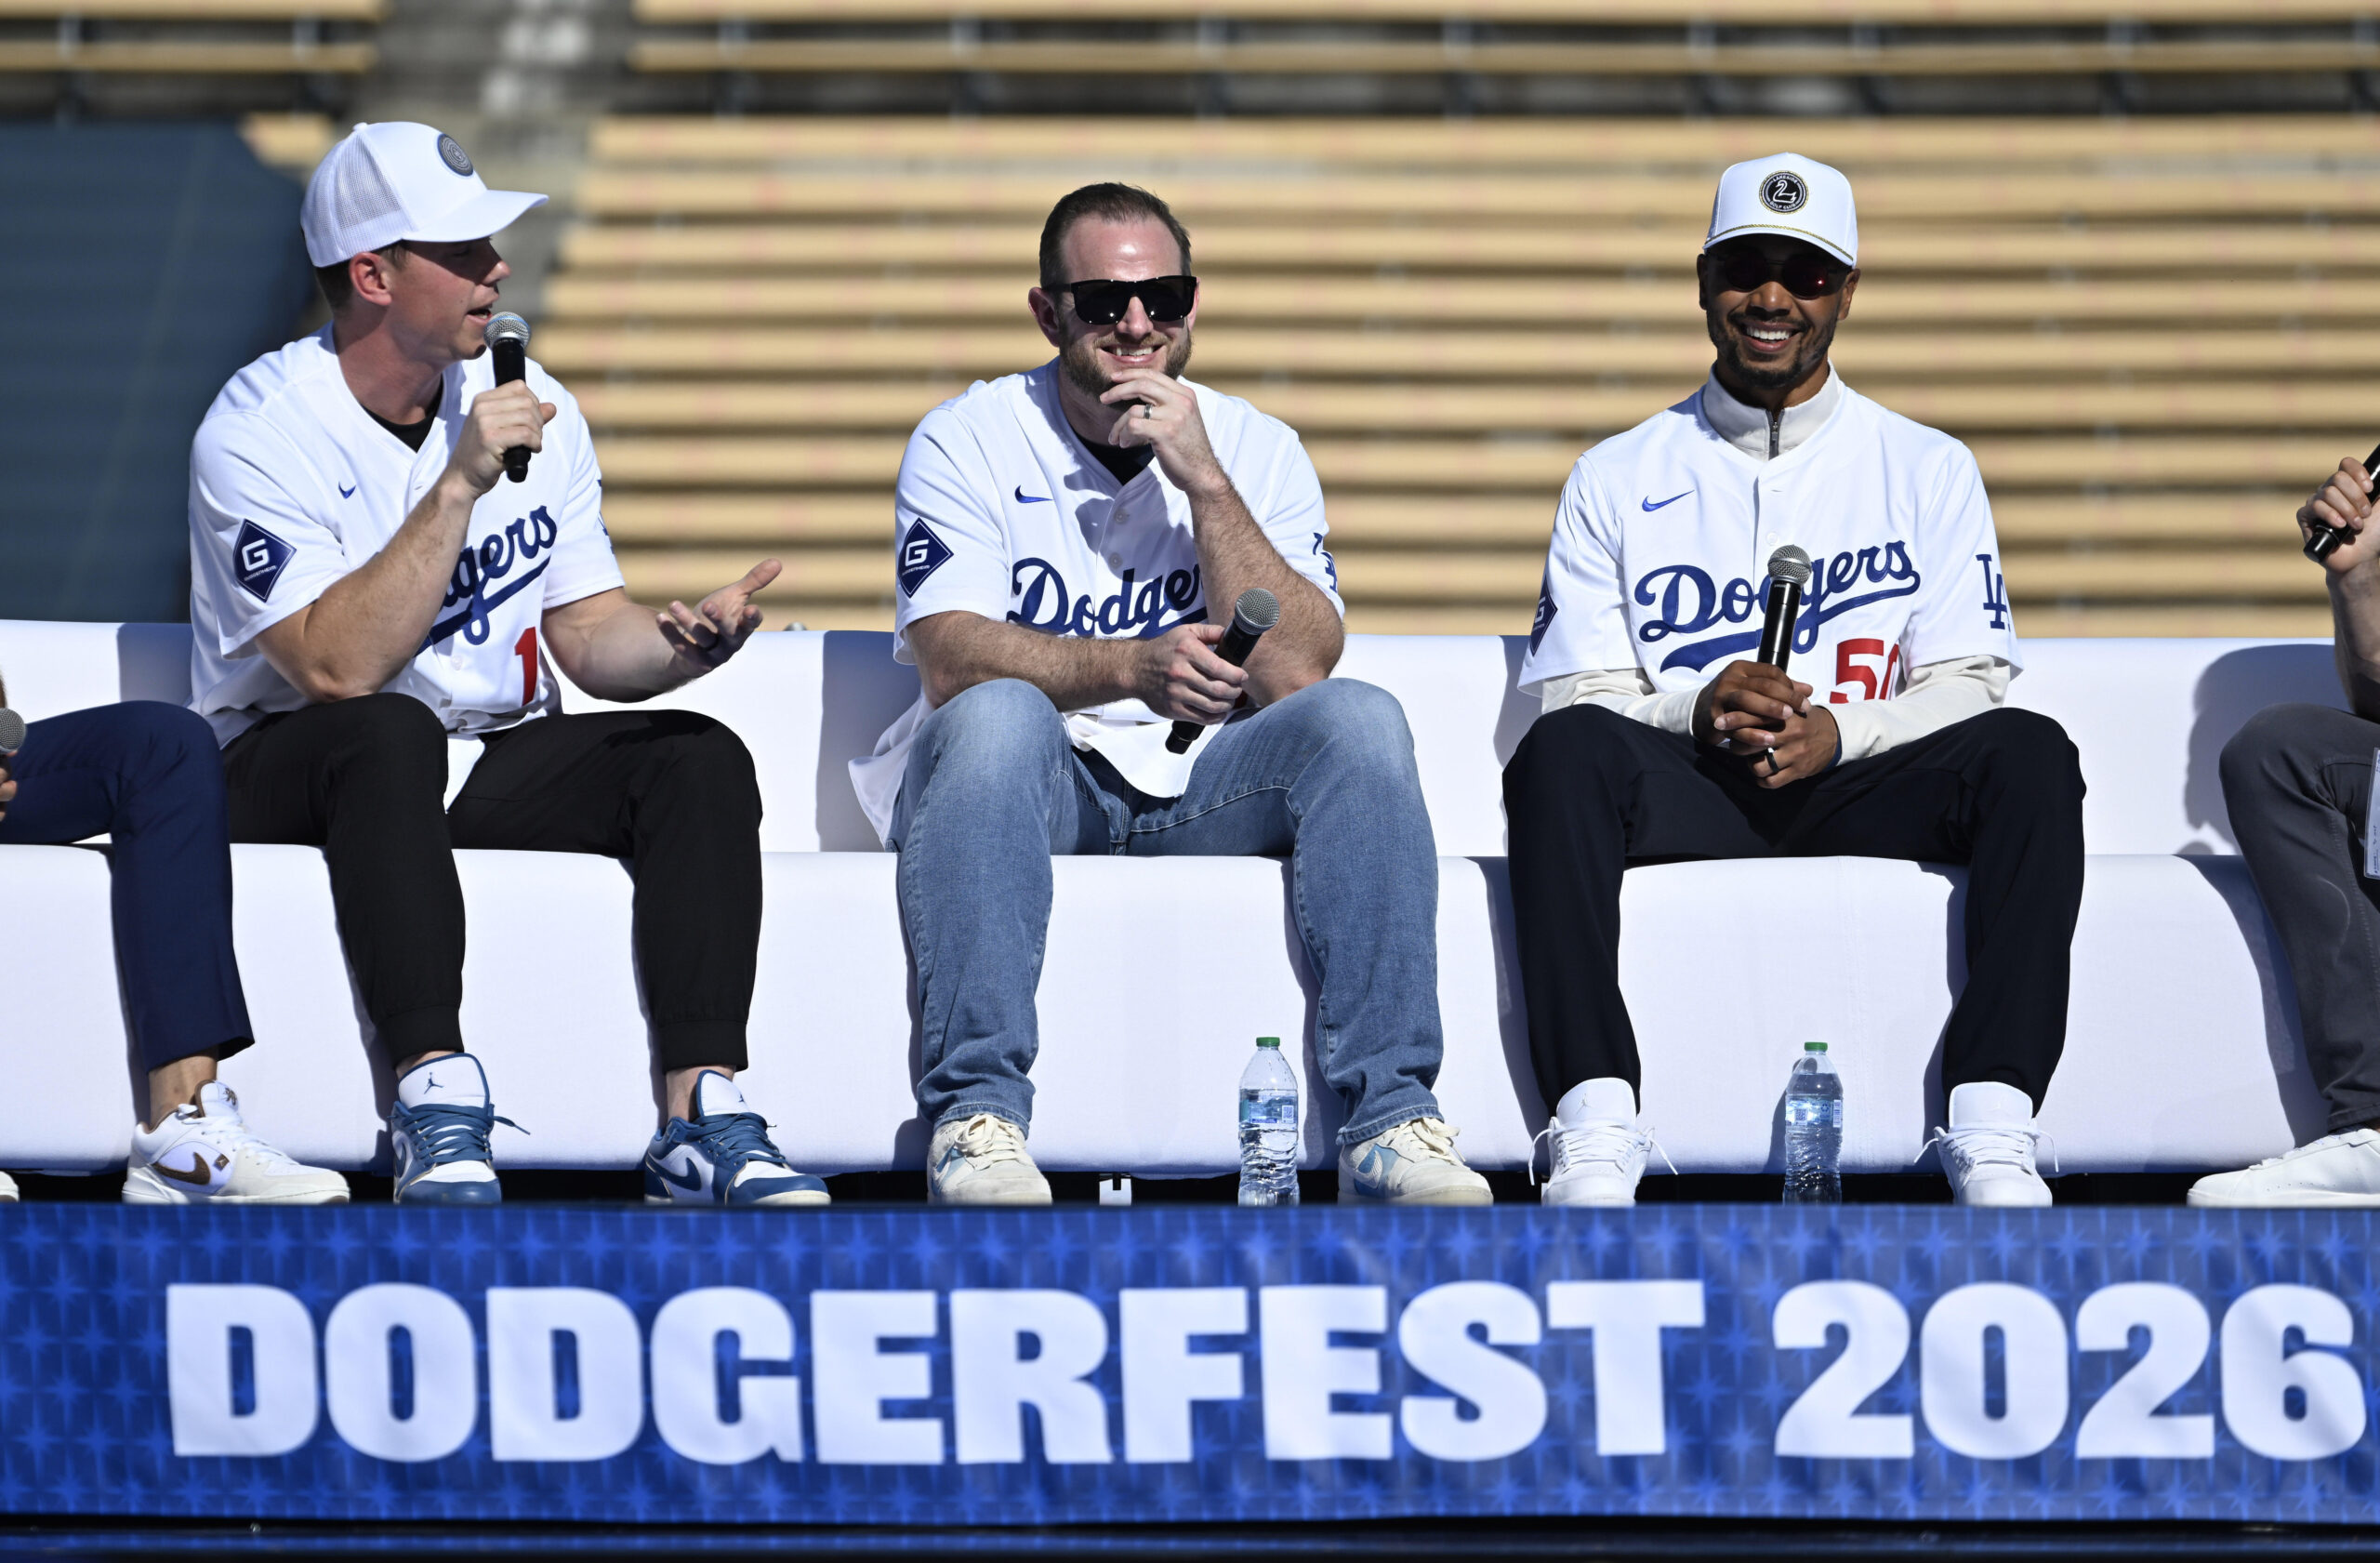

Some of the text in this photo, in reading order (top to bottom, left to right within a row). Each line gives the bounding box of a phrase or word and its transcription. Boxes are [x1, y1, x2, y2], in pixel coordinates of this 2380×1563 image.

[1773, 175, 1798, 183] LAKESIDE
[1770, 201, 1782, 209] GOLF
[242, 538, 270, 571] G
[905, 539, 929, 566] G
[437, 505, 558, 646] gers
[1007, 557, 1204, 640] Dodge
[165, 1279, 2367, 1465] DODGERFEST 2026
